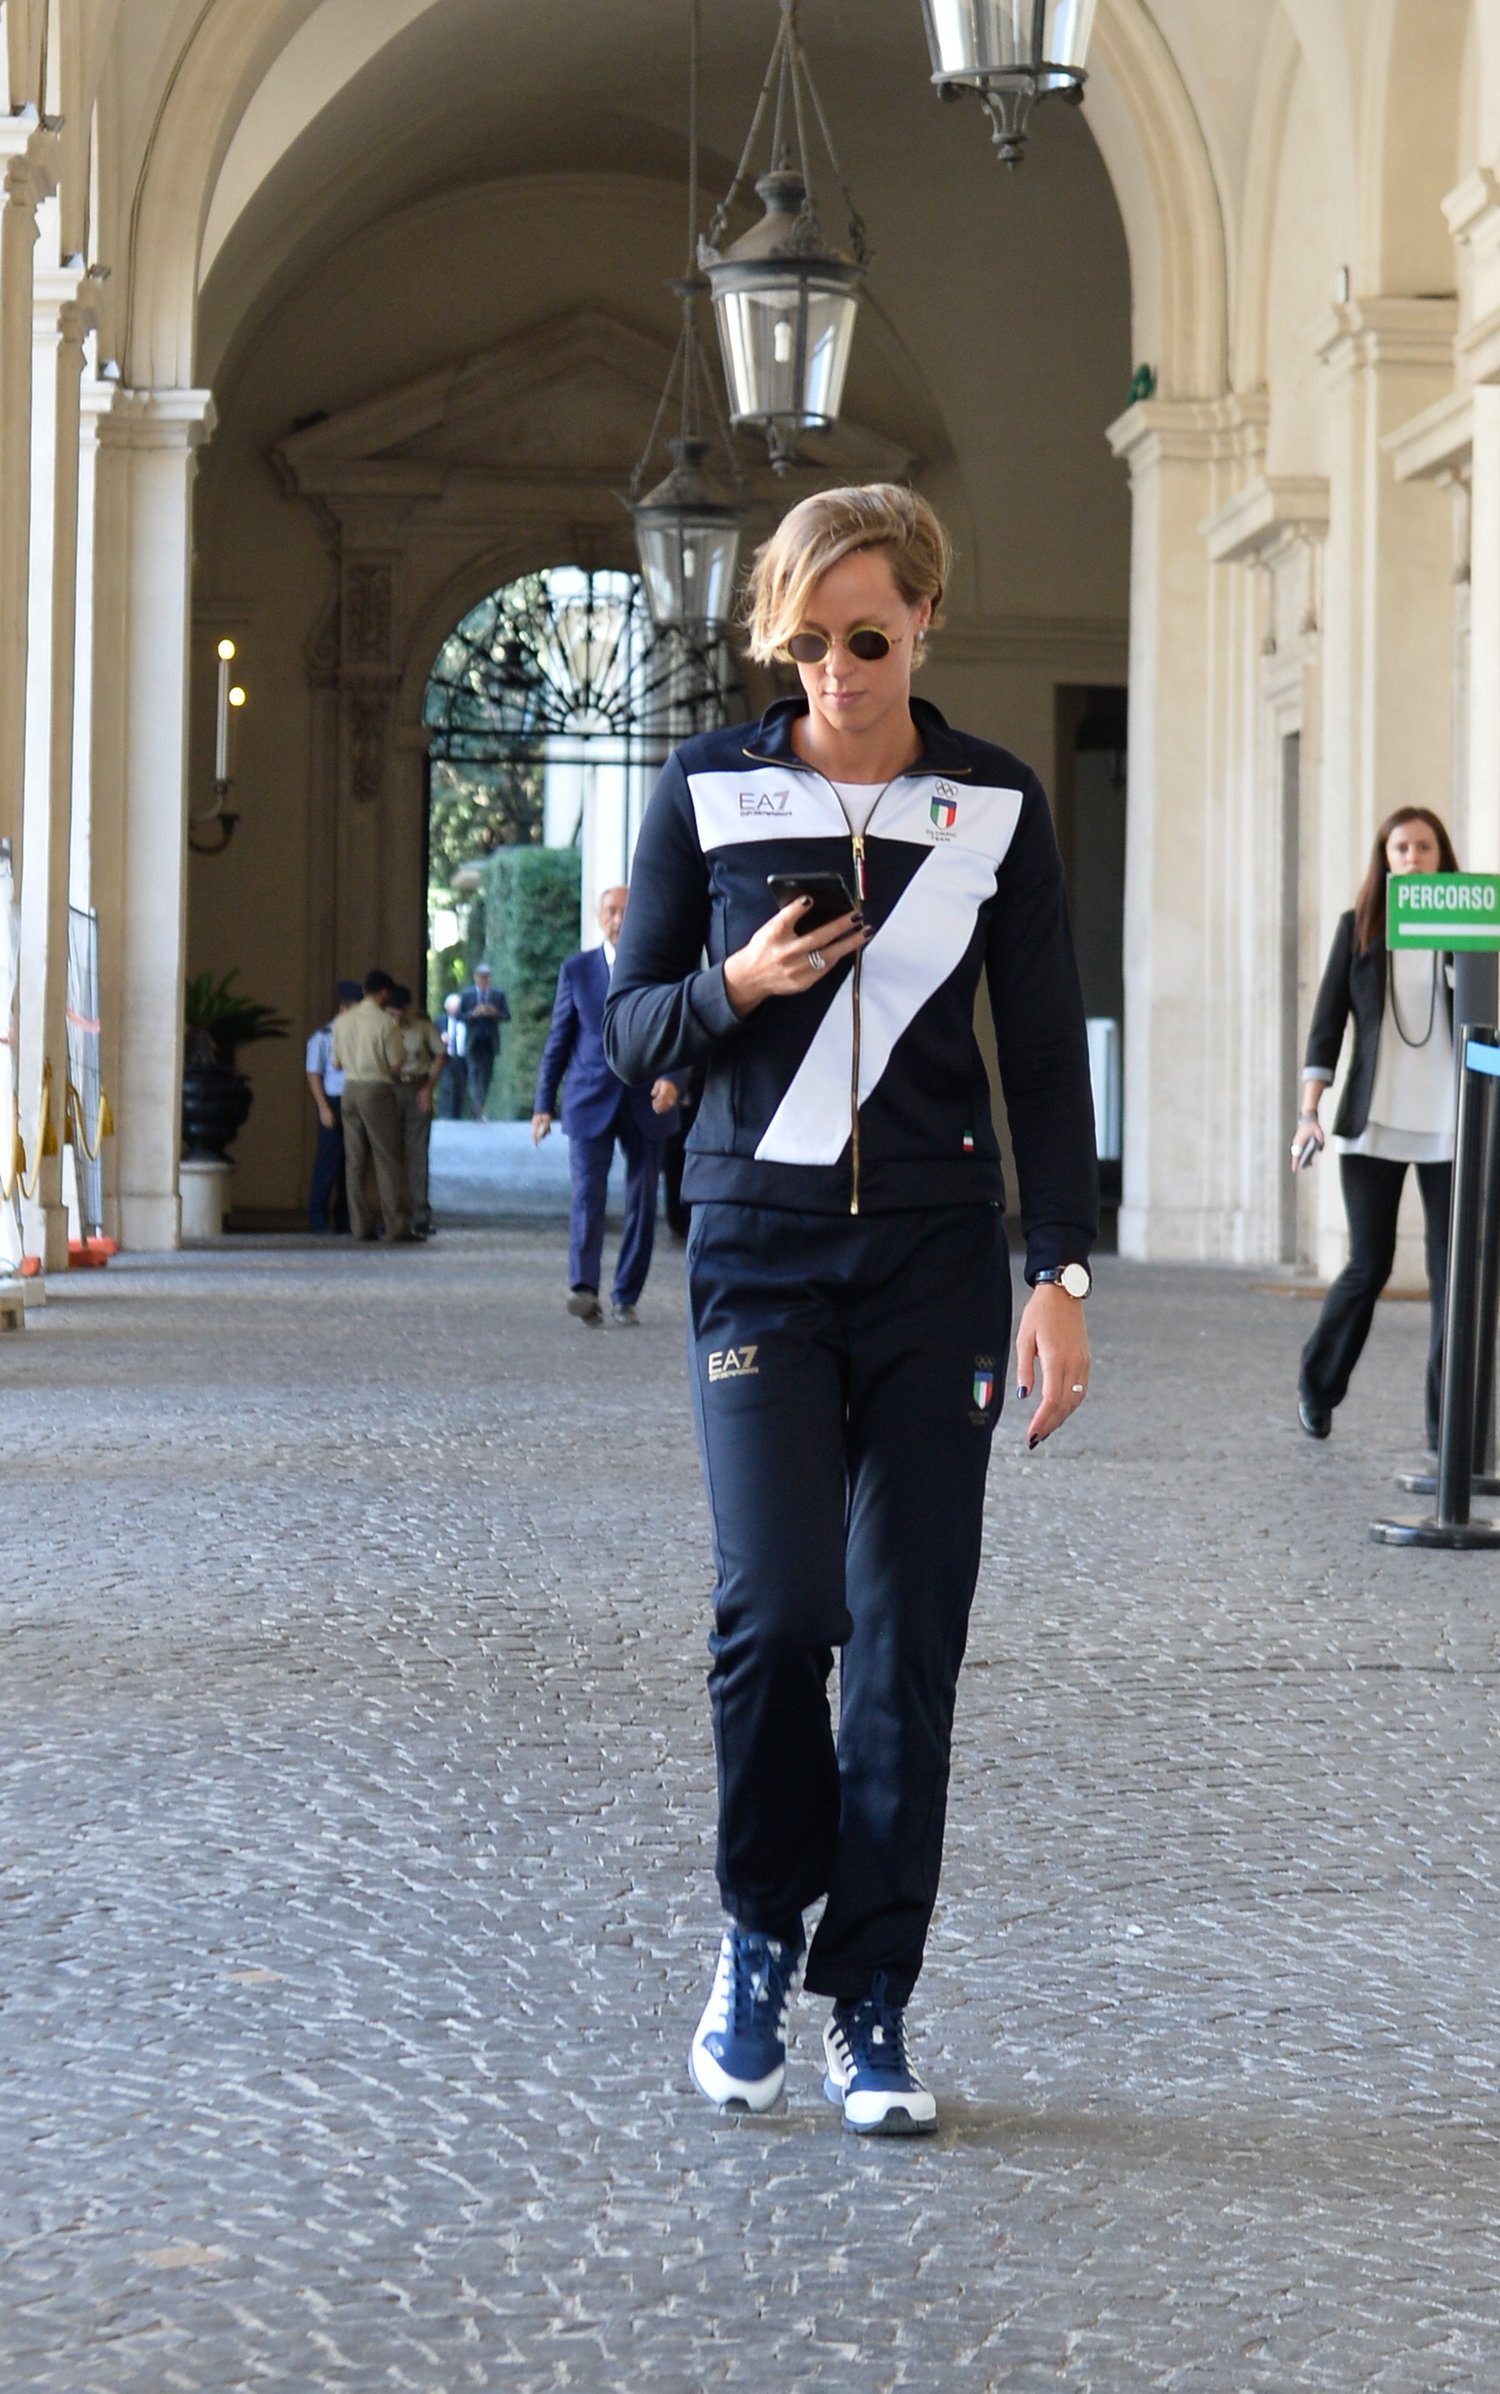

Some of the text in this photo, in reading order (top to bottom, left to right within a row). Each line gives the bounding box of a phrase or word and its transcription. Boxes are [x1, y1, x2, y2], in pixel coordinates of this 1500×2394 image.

[739, 790, 789, 810] EA7
[1398, 885, 1495, 910] PERCORSO
[709, 1346, 758, 1375] EA7
